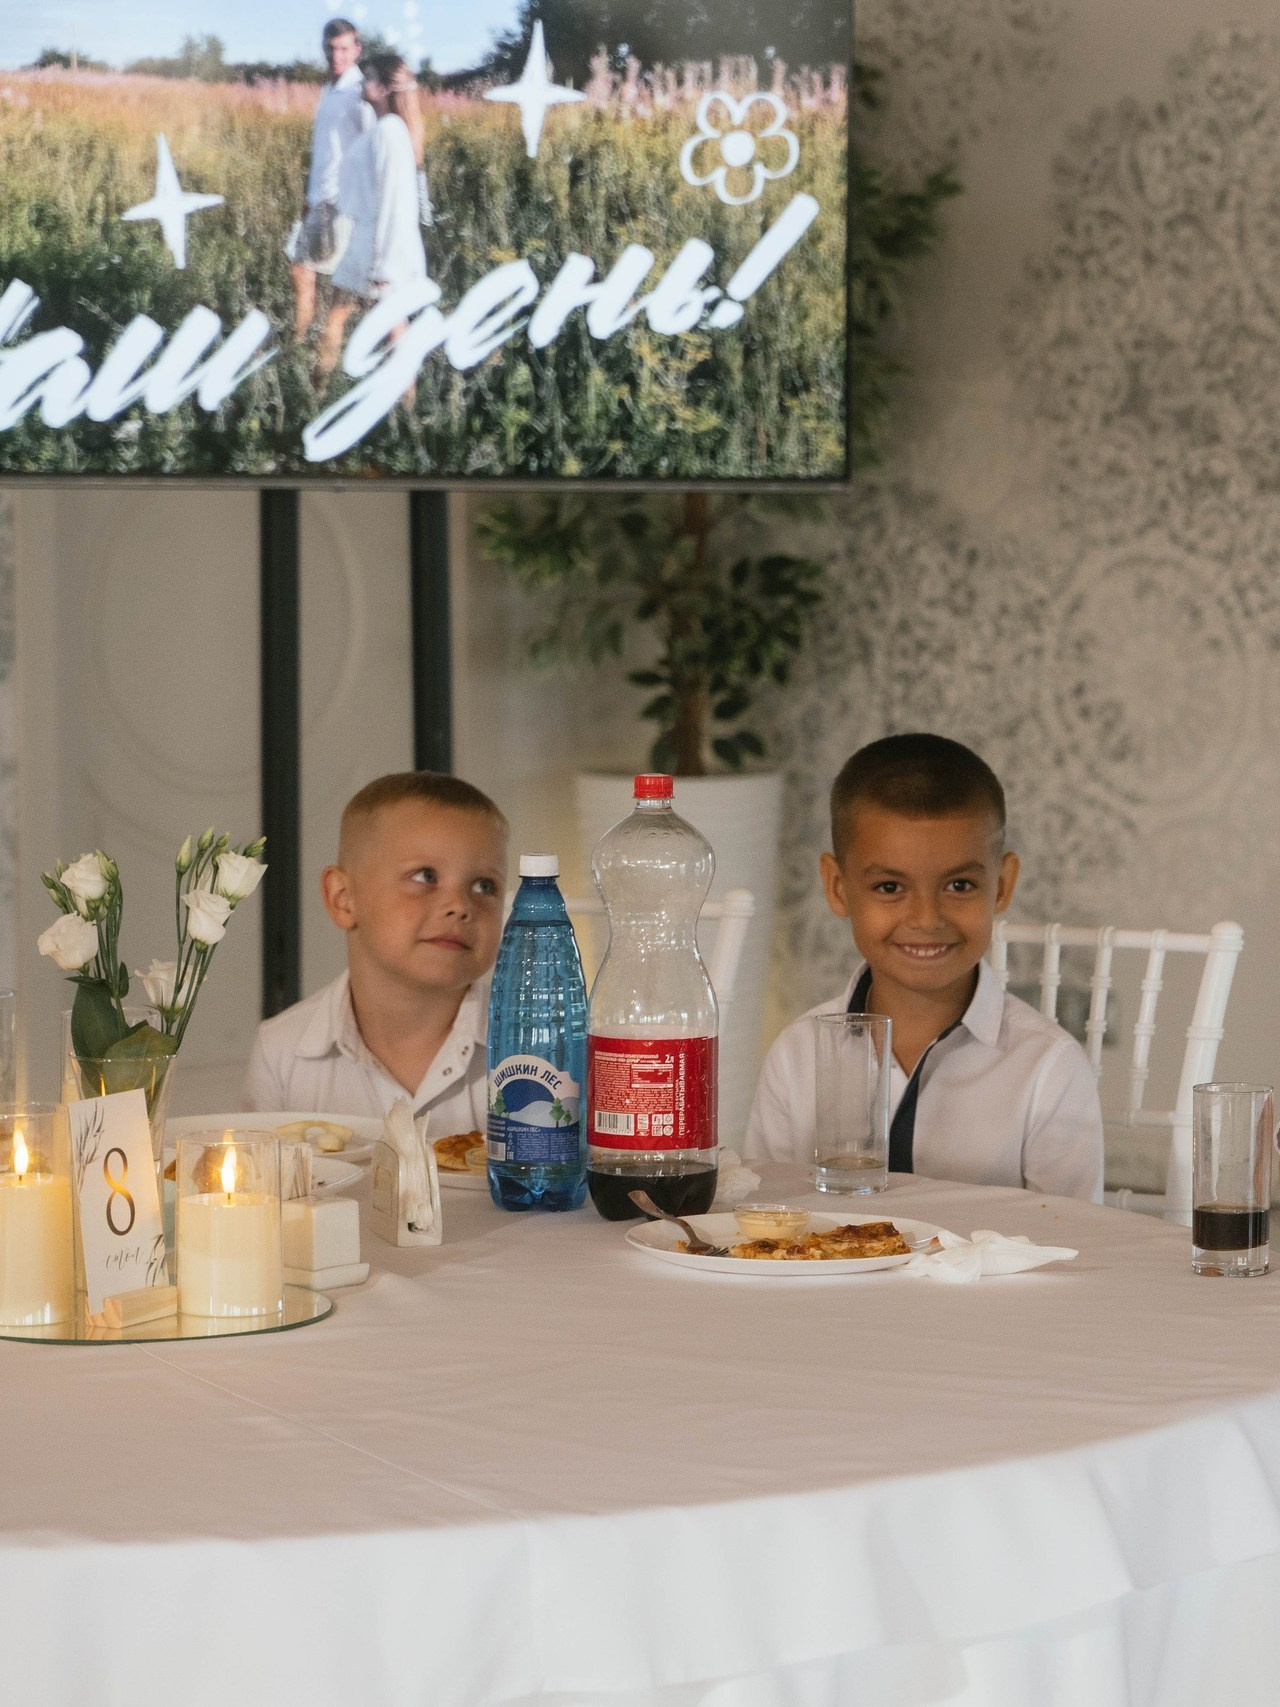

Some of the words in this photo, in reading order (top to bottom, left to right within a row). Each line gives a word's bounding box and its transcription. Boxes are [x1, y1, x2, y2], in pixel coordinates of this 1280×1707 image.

[303, 193, 820, 463] день!
[493, 1064, 538, 1087] ШИШКИН
[540, 1070, 562, 1090] ЛЕС
[103, 1147, 135, 1236] 8
